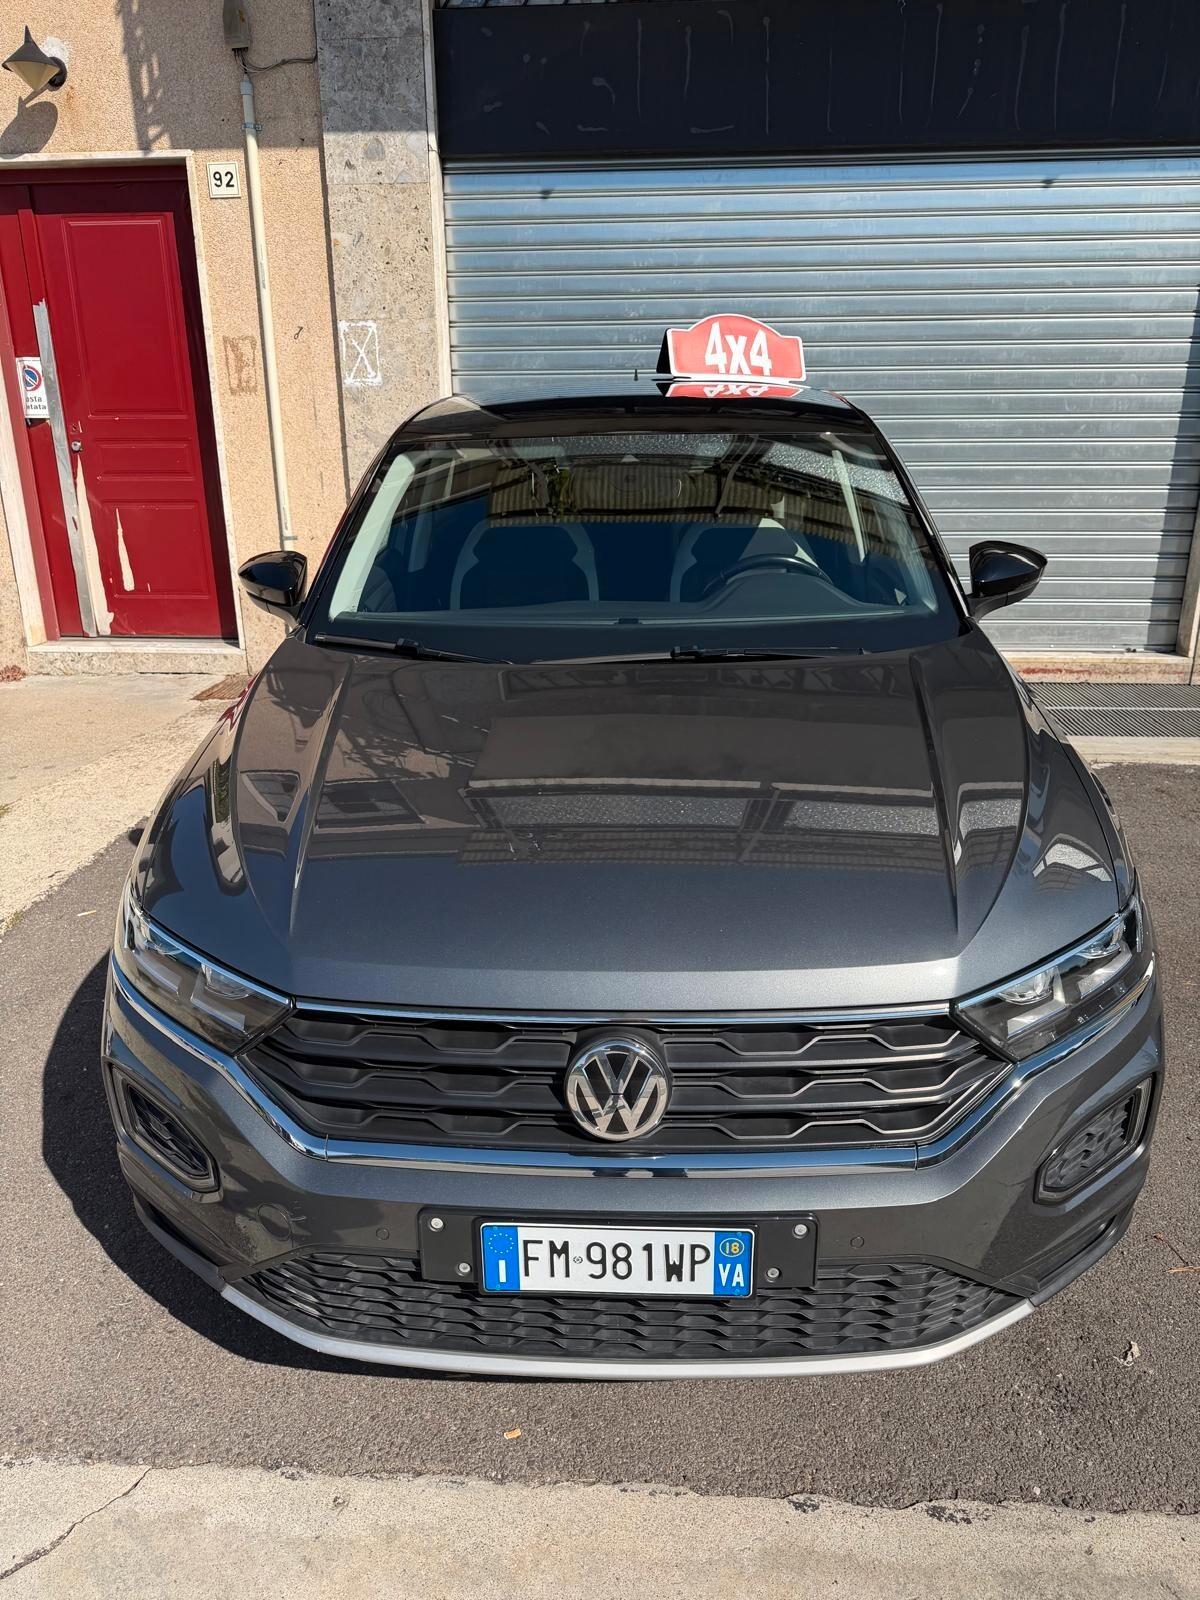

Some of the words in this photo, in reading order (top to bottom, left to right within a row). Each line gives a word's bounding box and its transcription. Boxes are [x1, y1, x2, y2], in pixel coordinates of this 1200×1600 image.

[213, 171, 235, 188] 92
[704, 321, 773, 377] 4x4
[25, 395, 43, 403] osta
[725, 1241, 740, 1254] 18
[718, 1263, 745, 1287] VA
